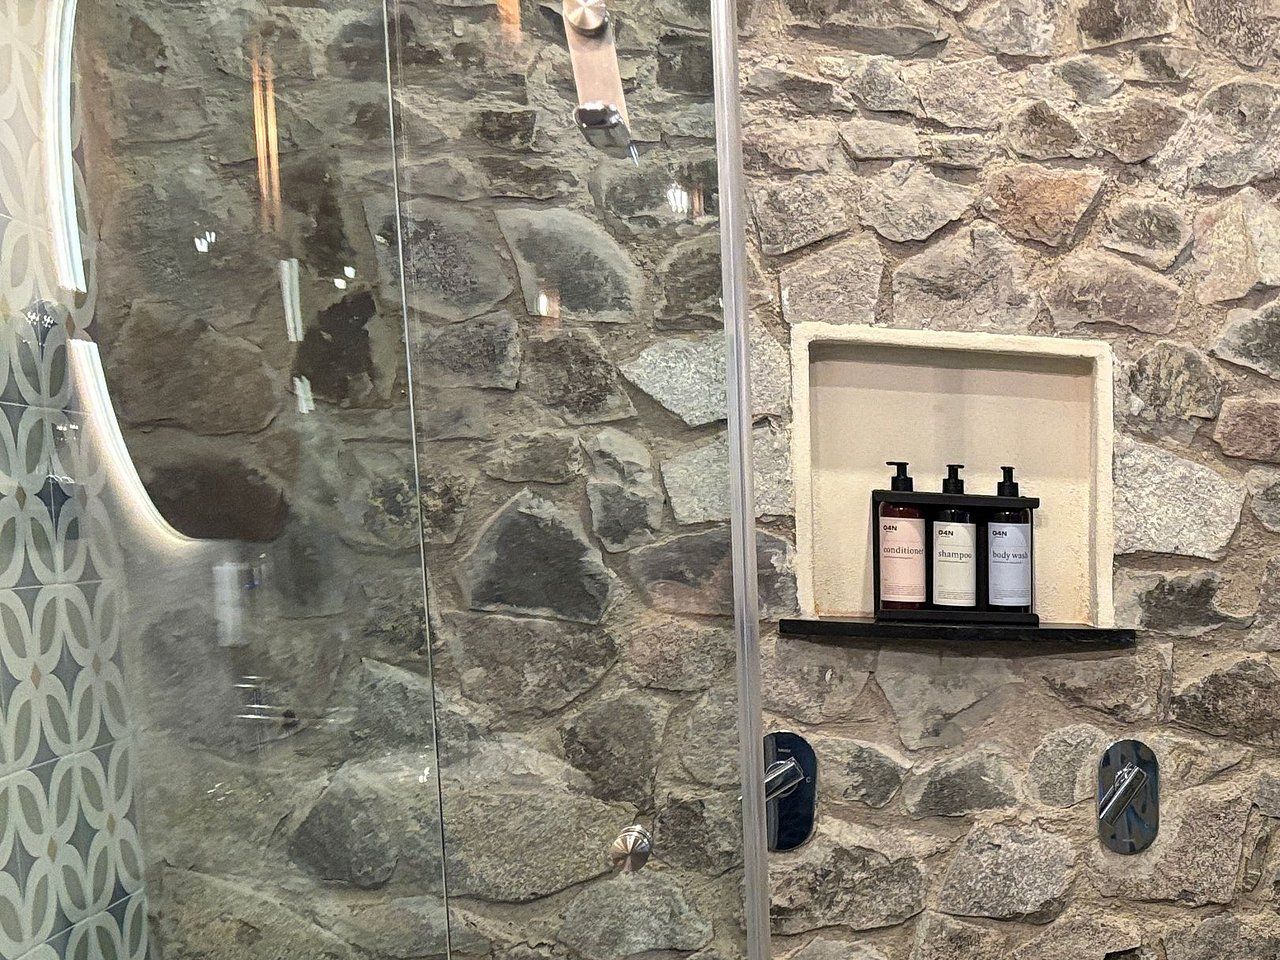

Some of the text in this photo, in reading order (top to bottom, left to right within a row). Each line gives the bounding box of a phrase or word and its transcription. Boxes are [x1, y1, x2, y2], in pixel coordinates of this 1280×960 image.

[883, 546, 924, 555] conditioner
[938, 550, 972, 560] shampoo
[992, 550, 1029, 561] body wash
